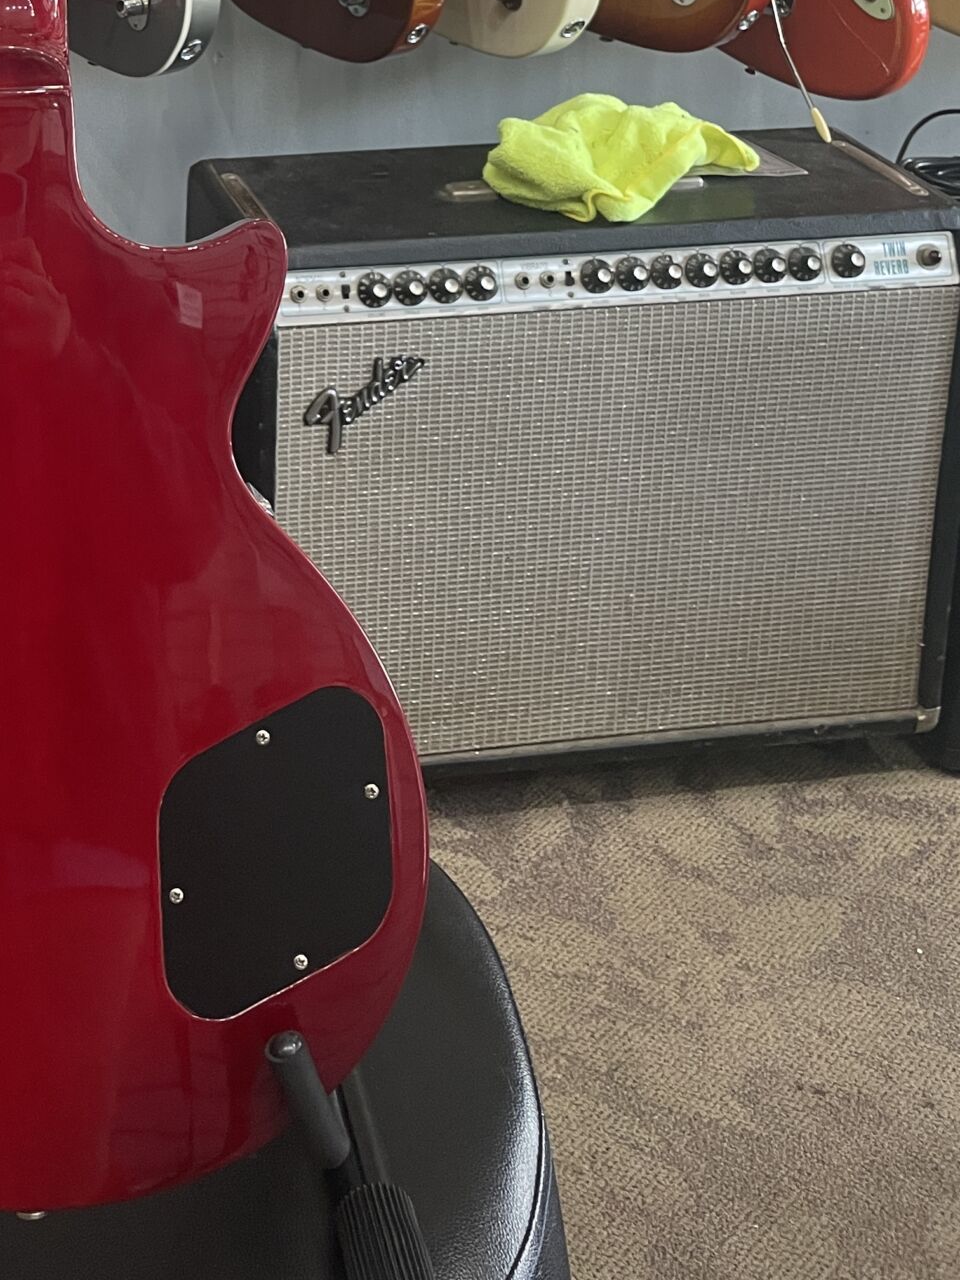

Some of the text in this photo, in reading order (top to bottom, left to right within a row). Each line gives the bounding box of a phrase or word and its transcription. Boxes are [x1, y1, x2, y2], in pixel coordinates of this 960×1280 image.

[881, 241, 907, 257] TWIN
[873, 258, 909, 276] REVERB
[303, 354, 425, 454] Fender
